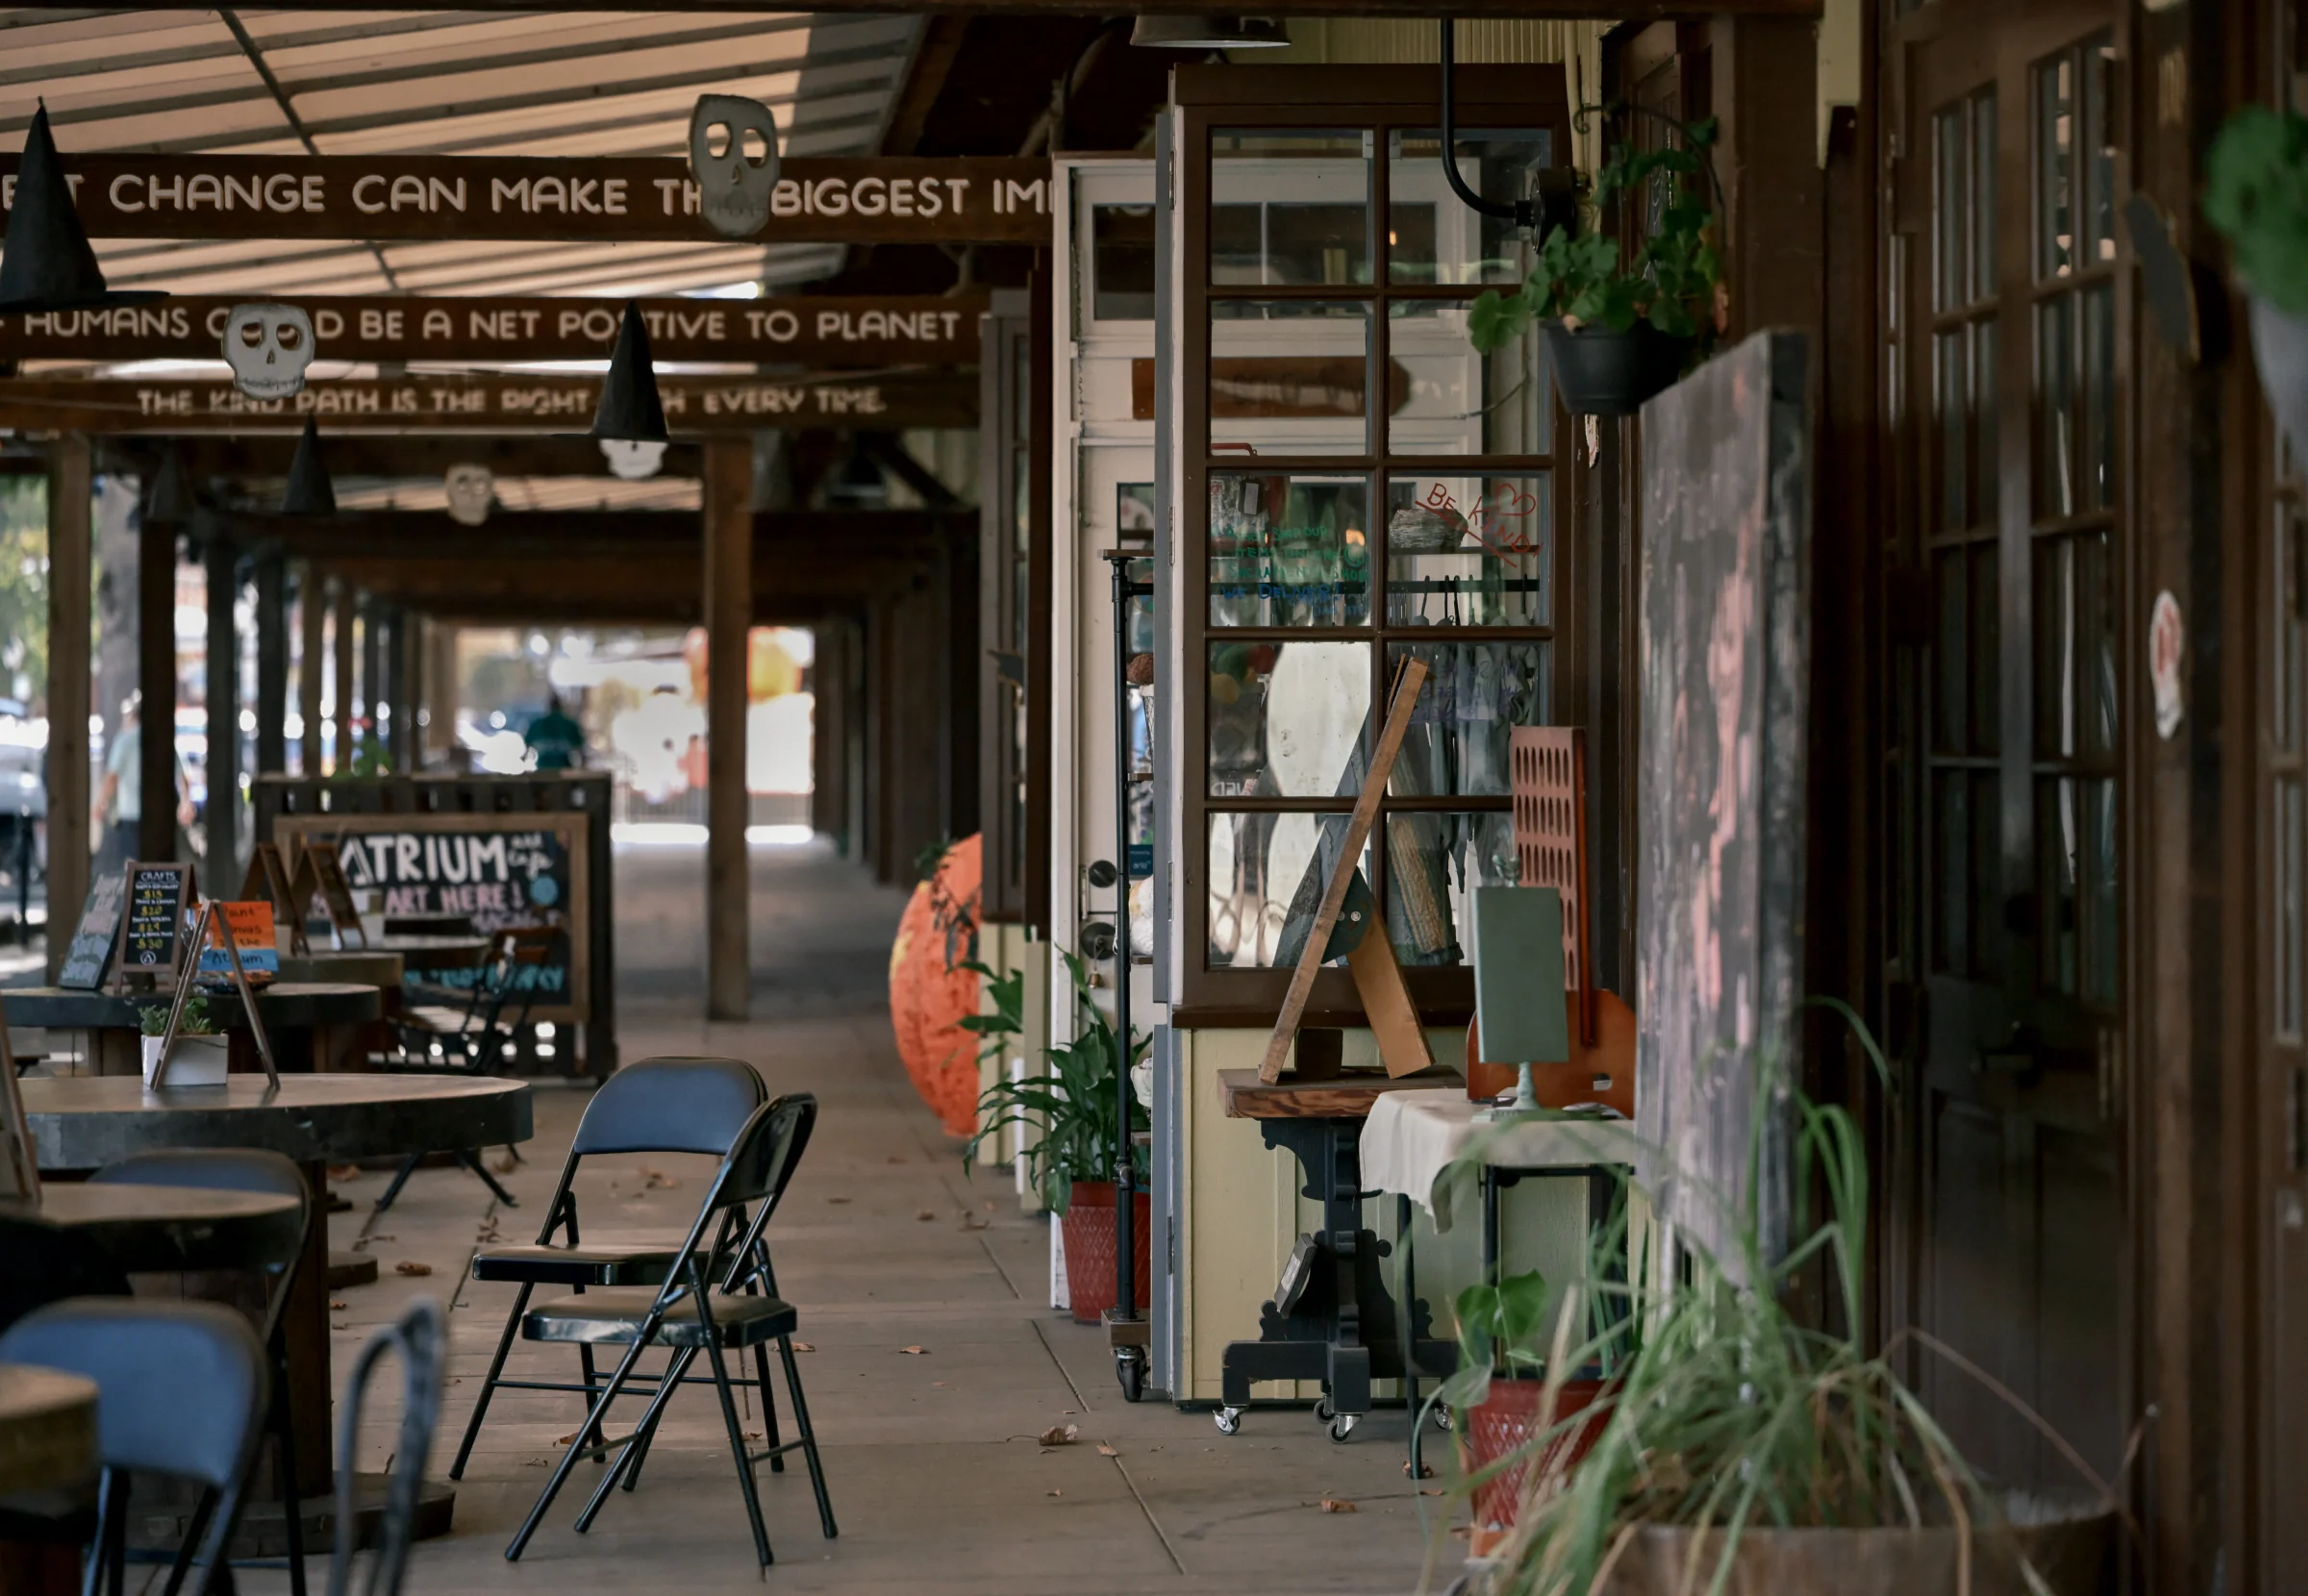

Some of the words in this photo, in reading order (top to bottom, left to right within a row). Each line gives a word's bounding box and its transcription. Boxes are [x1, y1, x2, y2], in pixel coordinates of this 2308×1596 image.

[2, 174, 85, 212] ET
[109, 173, 325, 213] CHANGE
[352, 174, 467, 214] CAN
[490, 176, 628, 215] MAKE
[653, 179, 702, 216] TH
[770, 179, 970, 217] BIGGEST
[993, 178, 1054, 215] IM
[24, 307, 189, 338] HUMANS
[361, 309, 404, 339] BE
[422, 308, 452, 339] A
[470, 309, 539, 340] NET
[558, 308, 726, 342] POTIVE
[744, 310, 800, 343] TO
[816, 311, 961, 341] PLANET
[138, 389, 192, 414] THE
[295, 387, 379, 414] PATH
[391, 388, 417, 413] IS
[431, 388, 486, 413] THE
[703, 388, 805, 414] EVERY
[1427, 483, 1456, 514] BE
[1220, 585, 1249, 600] WE
[339, 833, 510, 885] ATRIUM
[140, 871, 175, 882] CRAFTS
[386, 885, 429, 912] ART
[212, 951, 264, 966] Atum
